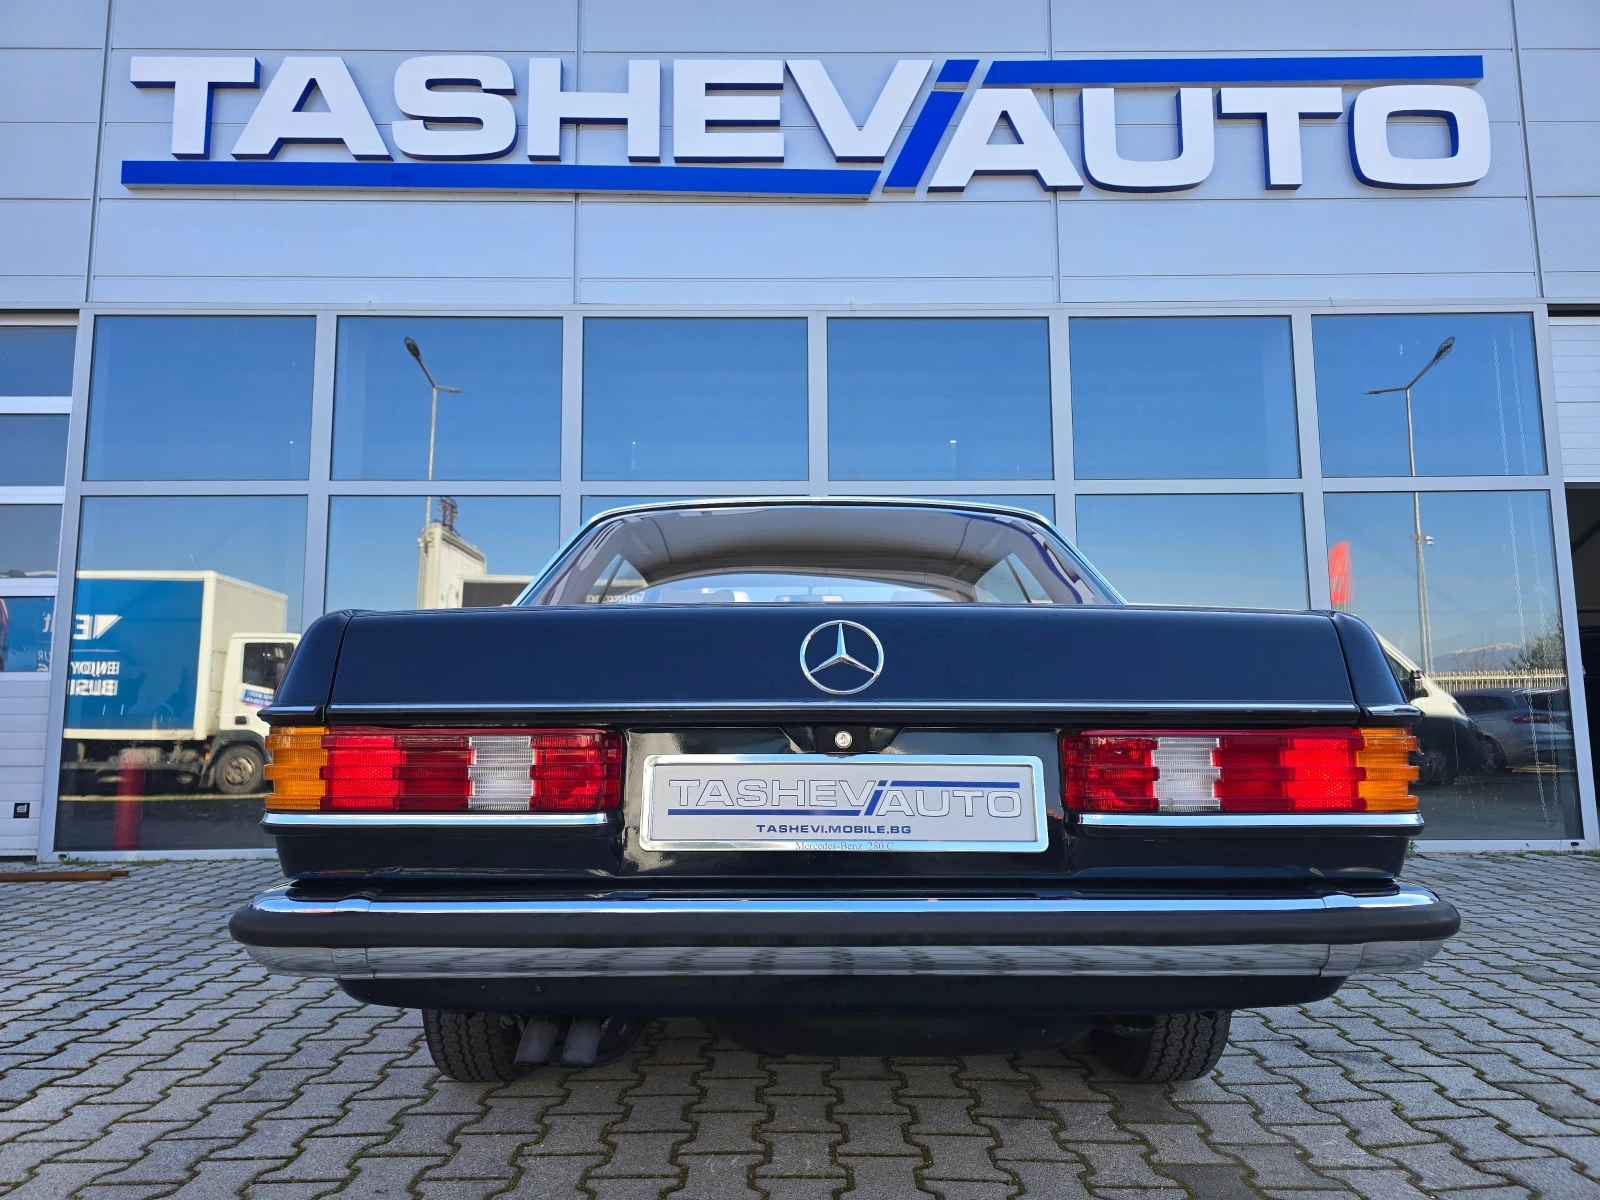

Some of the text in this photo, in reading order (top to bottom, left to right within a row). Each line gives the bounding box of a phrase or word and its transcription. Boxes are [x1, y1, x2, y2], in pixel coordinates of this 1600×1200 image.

[756, 824, 912, 835] TASHEVI.MOBILE.BG
[795, 841, 863, 851] Mercedes-Benz
[867, 841, 885, 851] 280
